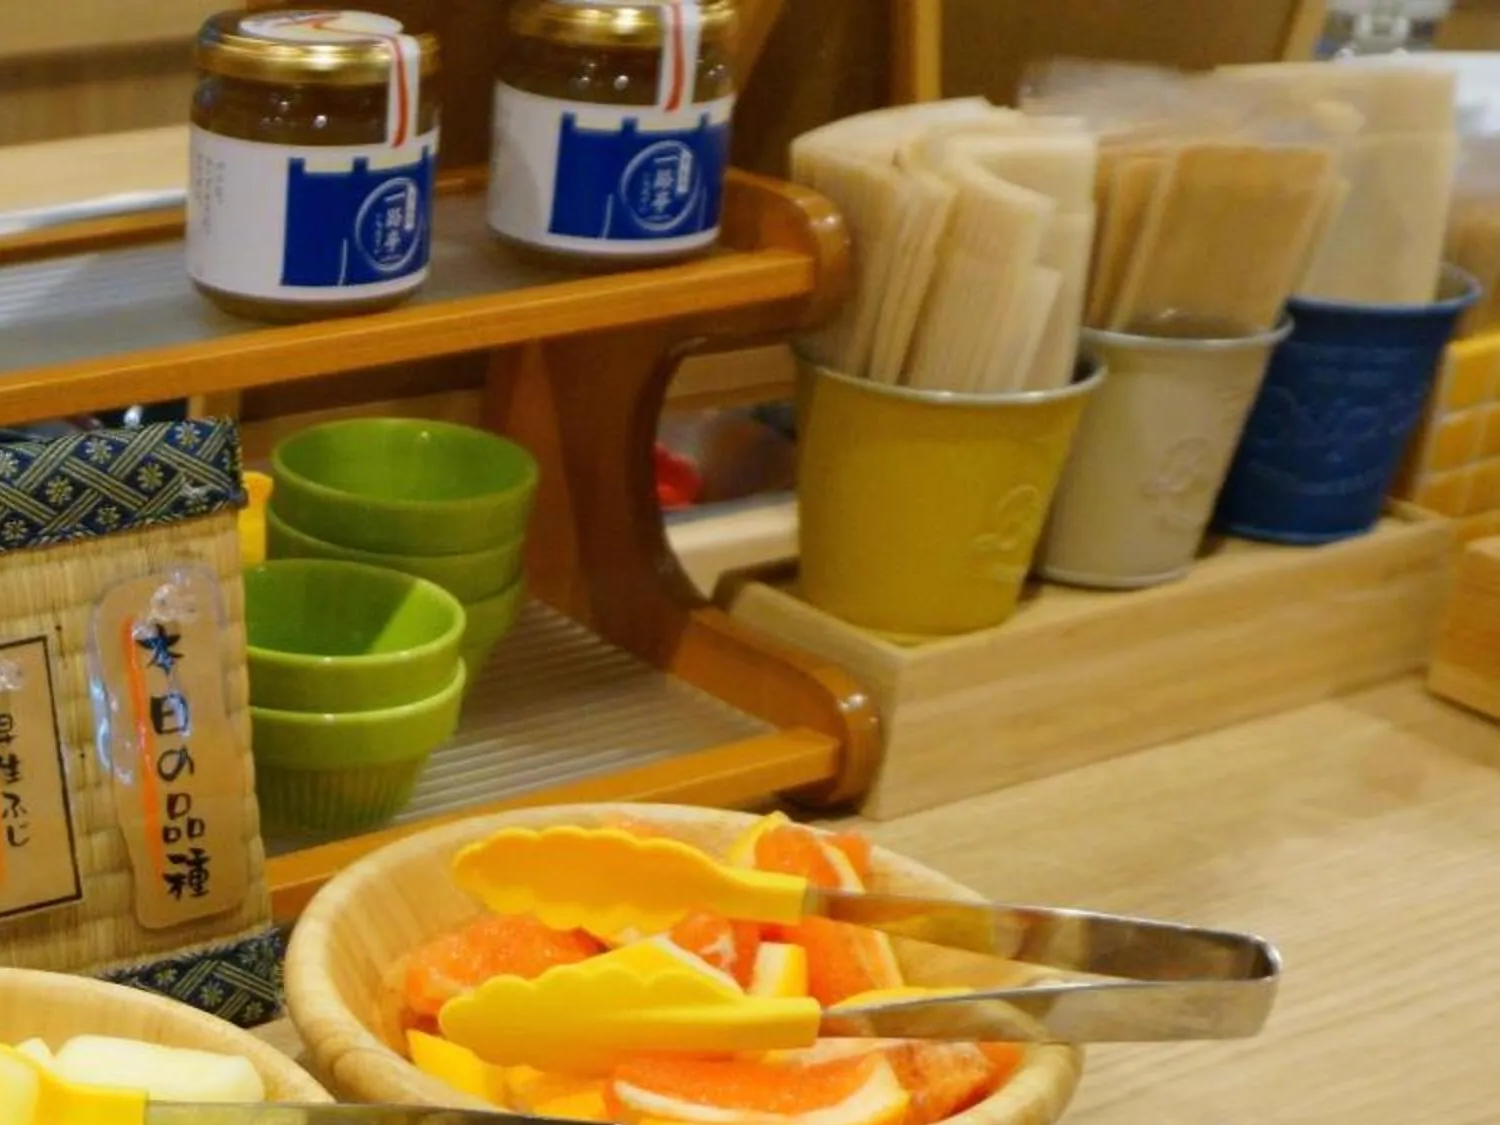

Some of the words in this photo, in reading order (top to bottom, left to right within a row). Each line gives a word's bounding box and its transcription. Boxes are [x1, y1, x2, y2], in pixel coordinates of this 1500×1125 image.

[135, 622, 211, 900] 本日の品種
